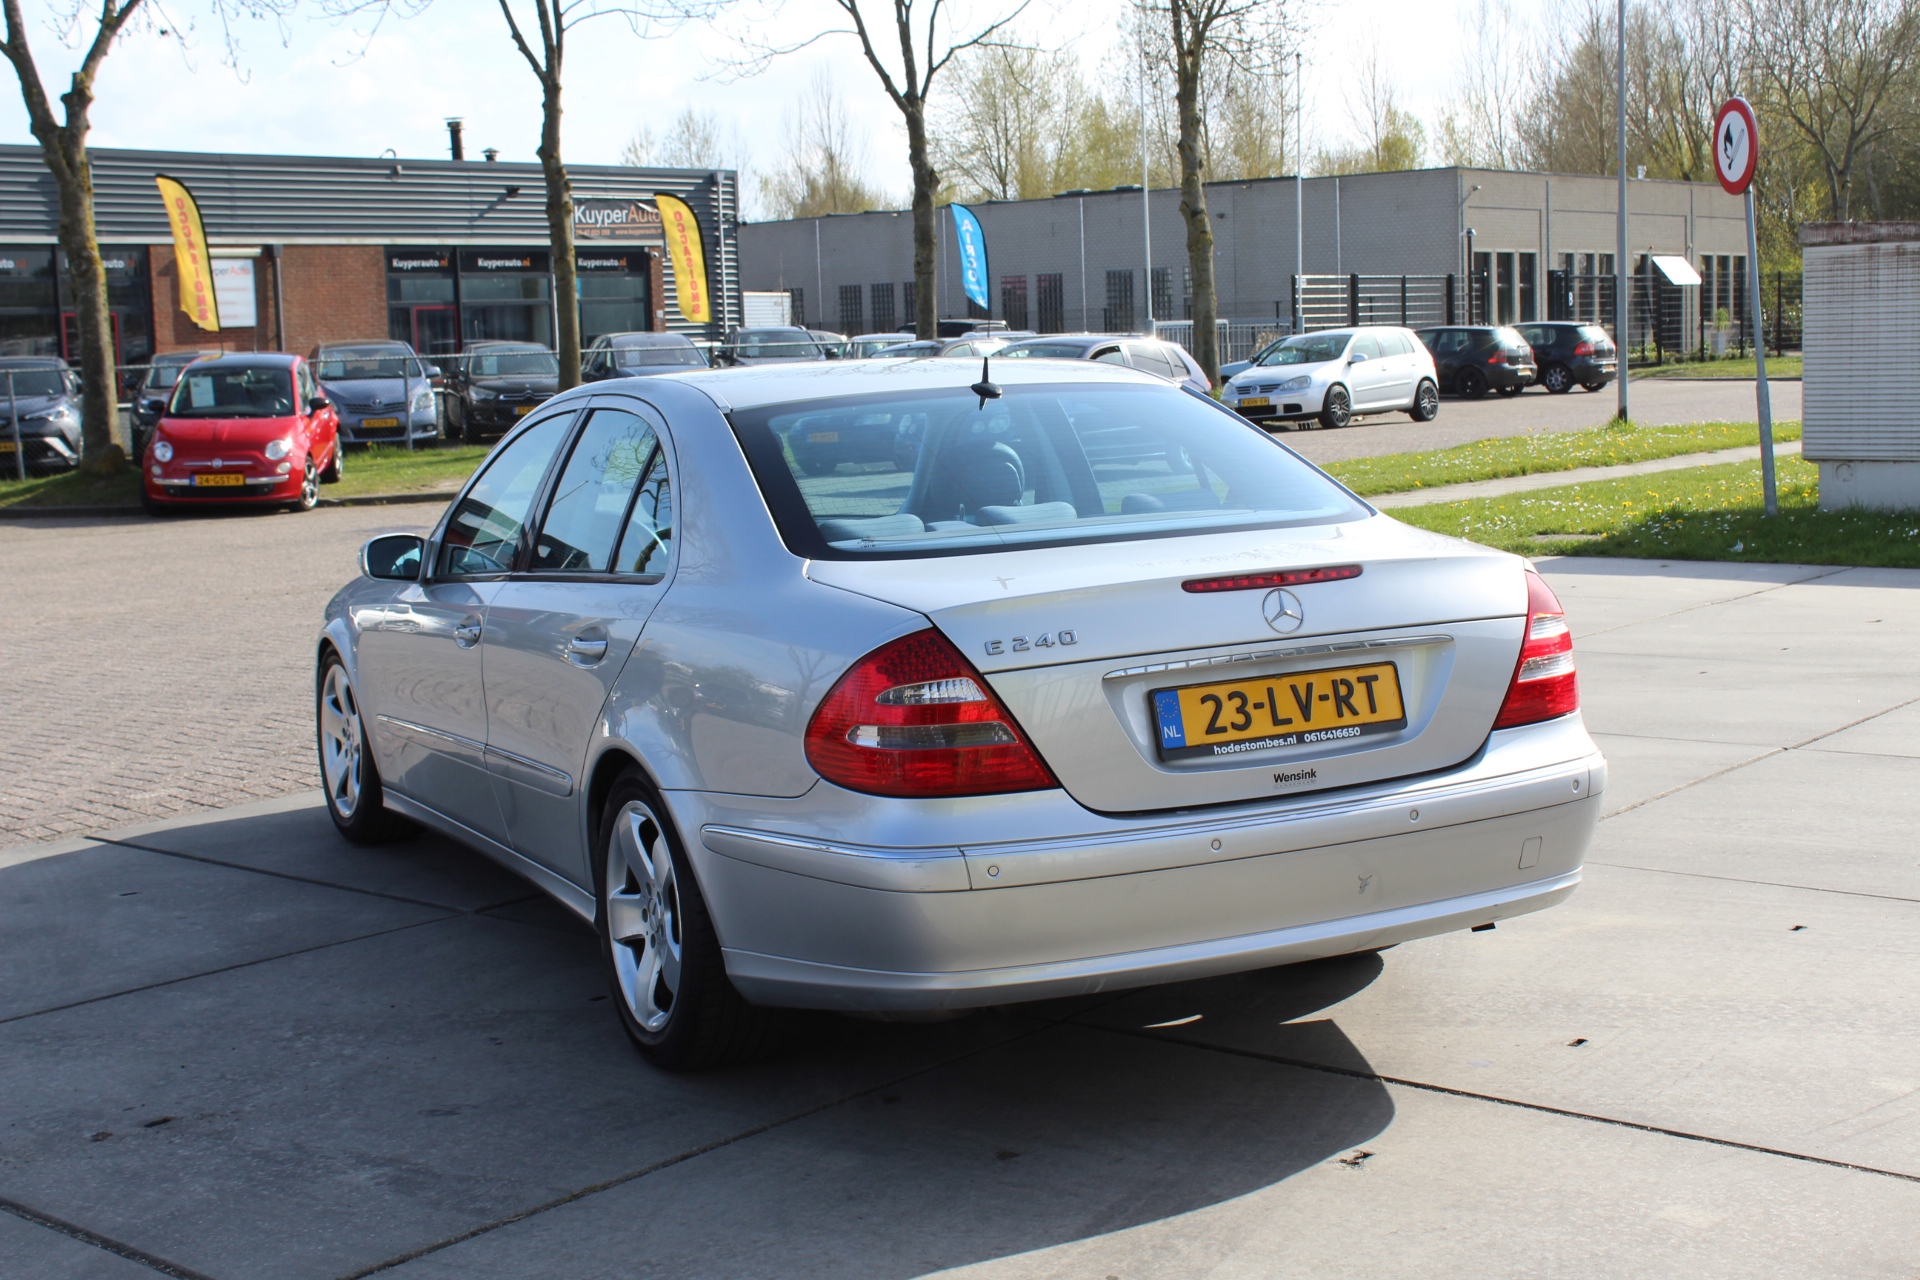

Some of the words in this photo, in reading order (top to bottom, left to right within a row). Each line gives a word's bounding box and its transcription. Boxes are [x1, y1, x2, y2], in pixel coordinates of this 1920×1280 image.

[574, 205, 661, 227] KuyperAuto
[392, 257, 449, 270] Kuyperauto.nl
[477, 257, 531, 269] Kuyperauto.nl
[577, 257, 627, 269] Kuyperauto.nl
[984, 640, 1005, 656] E
[1012, 629, 1078, 652] 240
[1200, 674, 1379, 736] 23-LV-RT
[1163, 726, 1182, 739] NL
[1213, 734, 1297, 755] hodestombes.nl
[1304, 726, 1361, 743] 0616416650
[1273, 768, 1317, 783] Wensink
